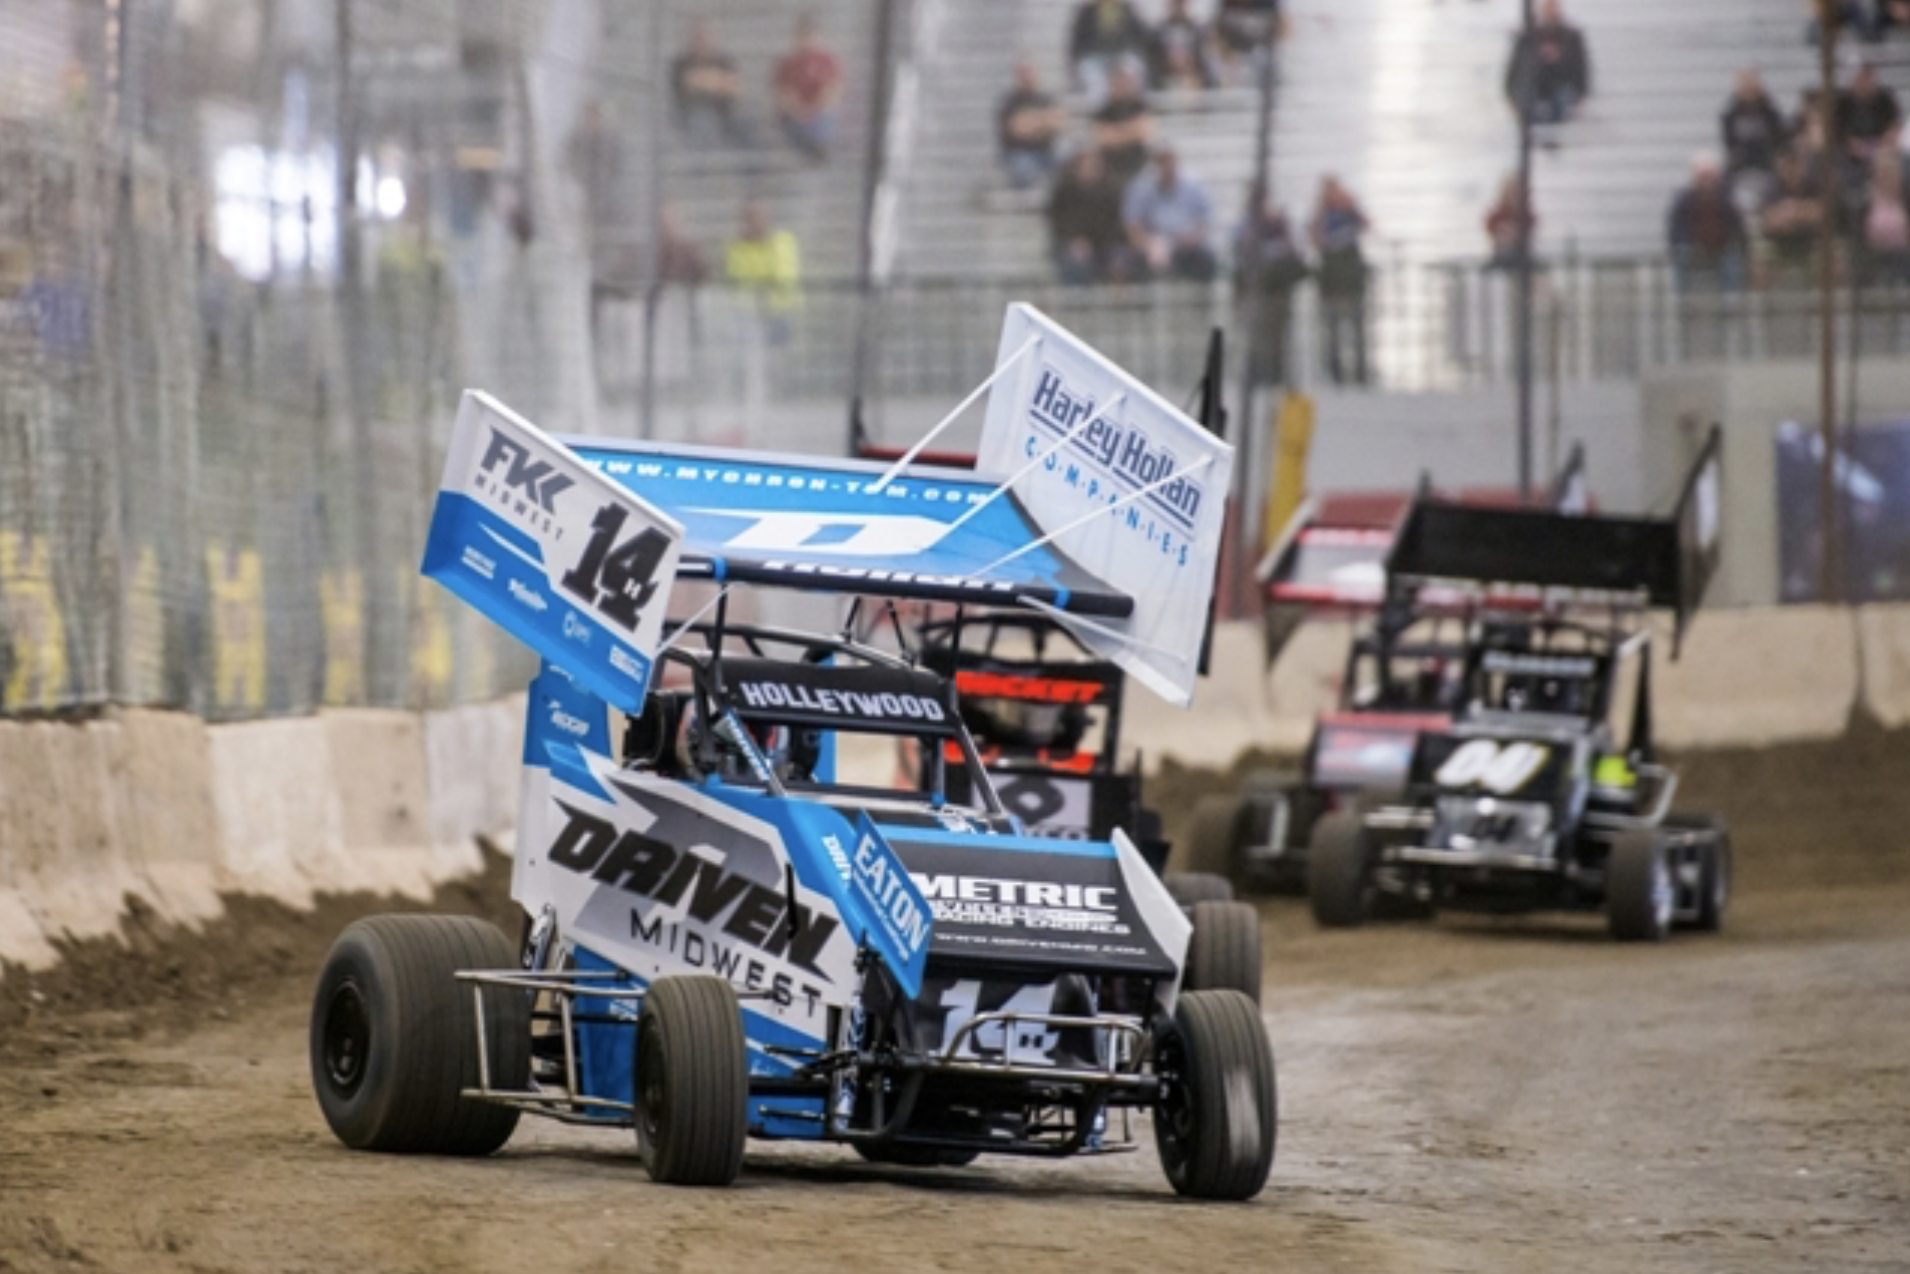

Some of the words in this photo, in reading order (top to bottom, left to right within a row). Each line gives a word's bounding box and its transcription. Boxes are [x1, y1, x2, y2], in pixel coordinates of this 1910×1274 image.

[1033, 370, 1121, 477] Harley
[1121, 430, 1201, 518] Hollan
[561, 501, 672, 634] 14
[739, 681, 944, 721] HOLLEYWOOD
[547, 796, 841, 985] DRIVEN
[854, 832, 931, 953] EATON
[907, 870, 1119, 911] METRIC
[630, 908, 822, 1017] MIDWEST
[938, 978, 1061, 1067] 14
